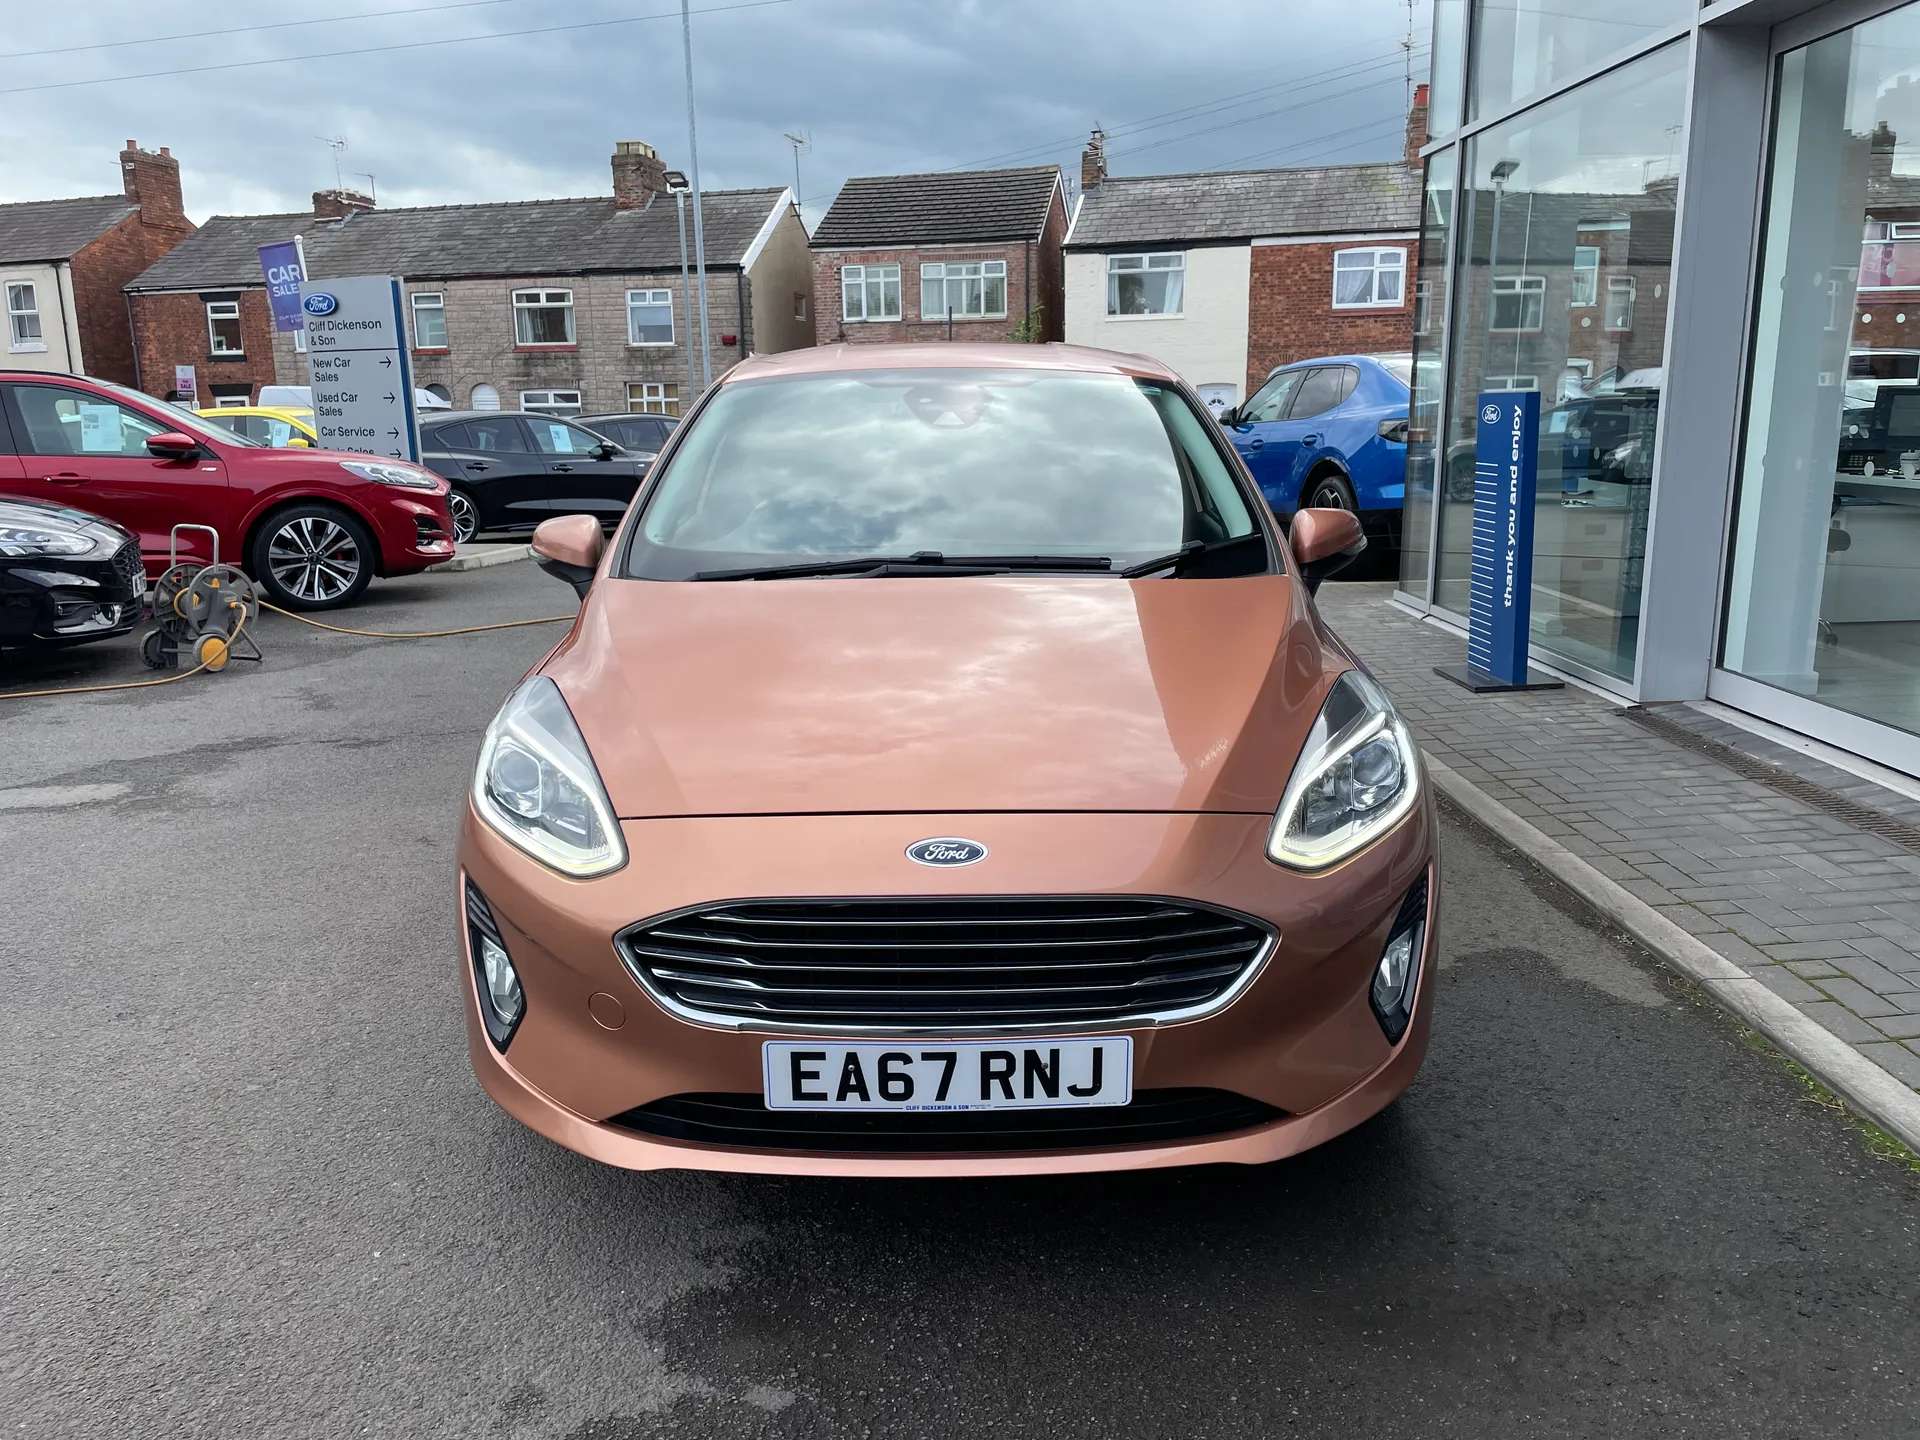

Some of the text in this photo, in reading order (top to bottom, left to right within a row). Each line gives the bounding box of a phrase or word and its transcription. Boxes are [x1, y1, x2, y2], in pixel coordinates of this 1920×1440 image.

[268, 264, 301, 284] CAR
[309, 319, 382, 332] Cliff Dickenson
[311, 335, 336, 345] & Son
[313, 357, 351, 368] New Car
[315, 372, 339, 382] Sales
[317, 392, 358, 402] Used Car
[319, 406, 343, 416] Sales
[321, 426, 375, 436] Car Service
[1504, 404, 1522, 607] thank you and enjoy
[925, 843, 969, 860] Ford
[790, 1047, 1103, 1102] EA67 RNJ
